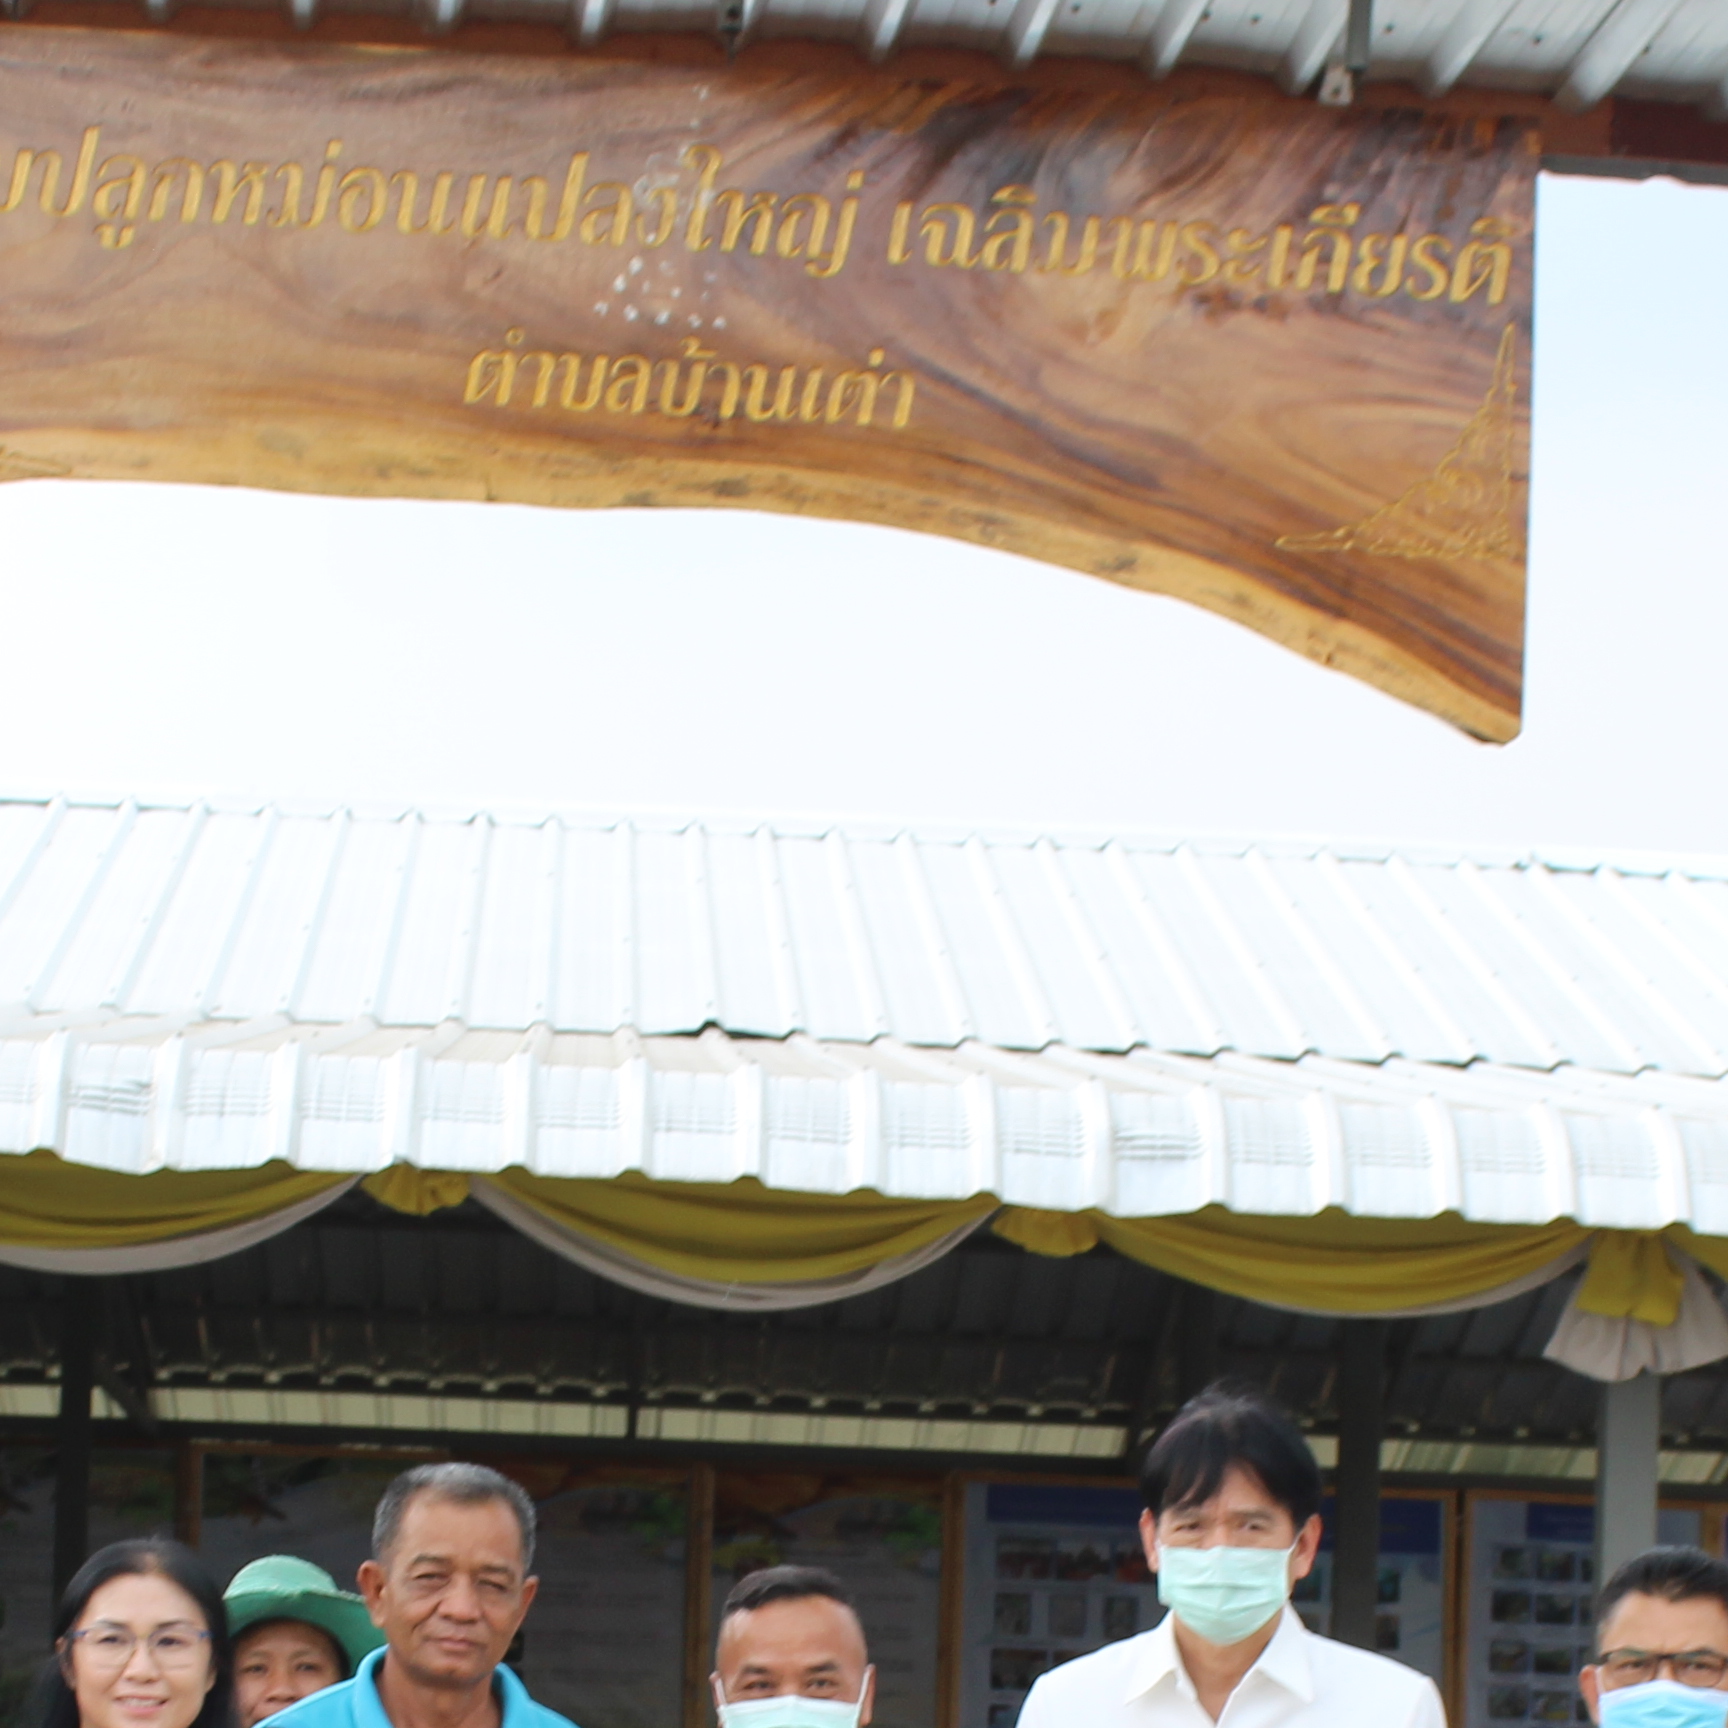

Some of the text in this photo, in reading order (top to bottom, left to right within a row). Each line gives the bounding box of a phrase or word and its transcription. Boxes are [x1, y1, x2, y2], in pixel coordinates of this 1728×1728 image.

[887, 185, 1518, 305] เฉลิมพระเกียรติ
[464, 327, 916, 429] ตำบลบ้านเต่า
